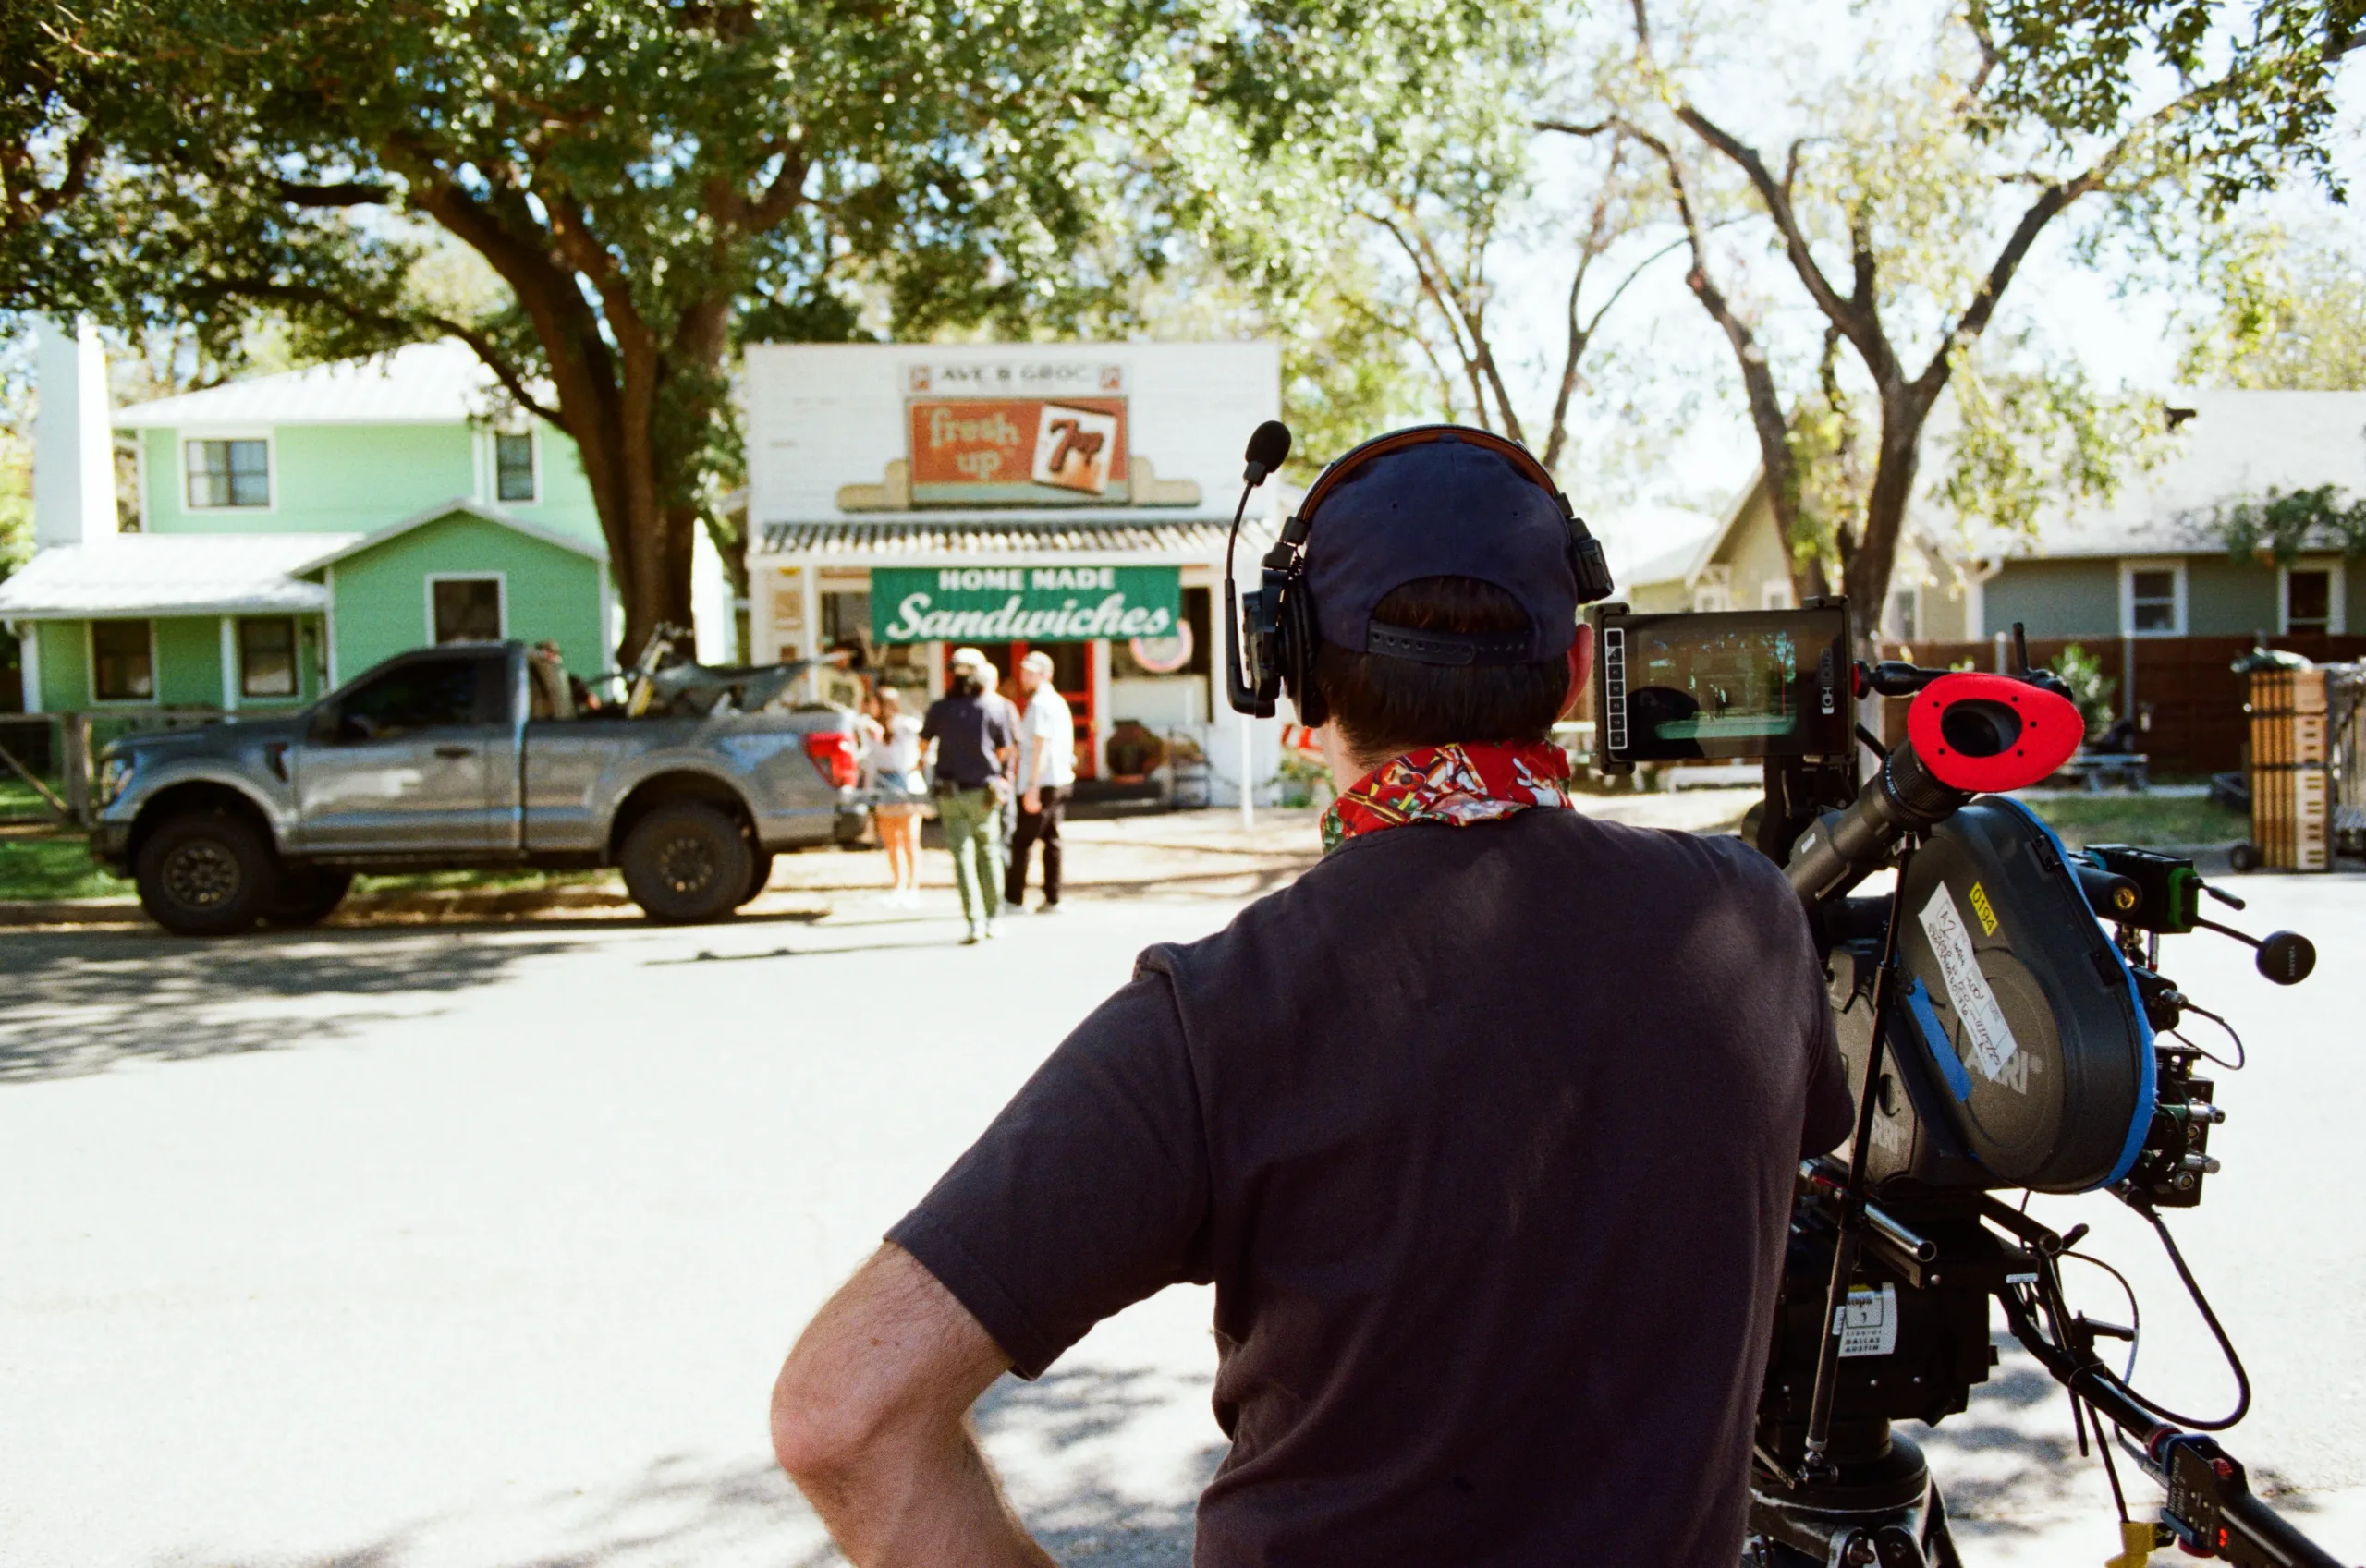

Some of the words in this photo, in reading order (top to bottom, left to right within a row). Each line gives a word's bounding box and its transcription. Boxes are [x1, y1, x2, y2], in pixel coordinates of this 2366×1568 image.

[940, 366, 983, 382] AVE
[938, 568, 1025, 592] HOME
[1032, 567, 1115, 591] MADE
[886, 592, 1171, 639] Sandwiches
[1971, 887, 1996, 933] 0194
